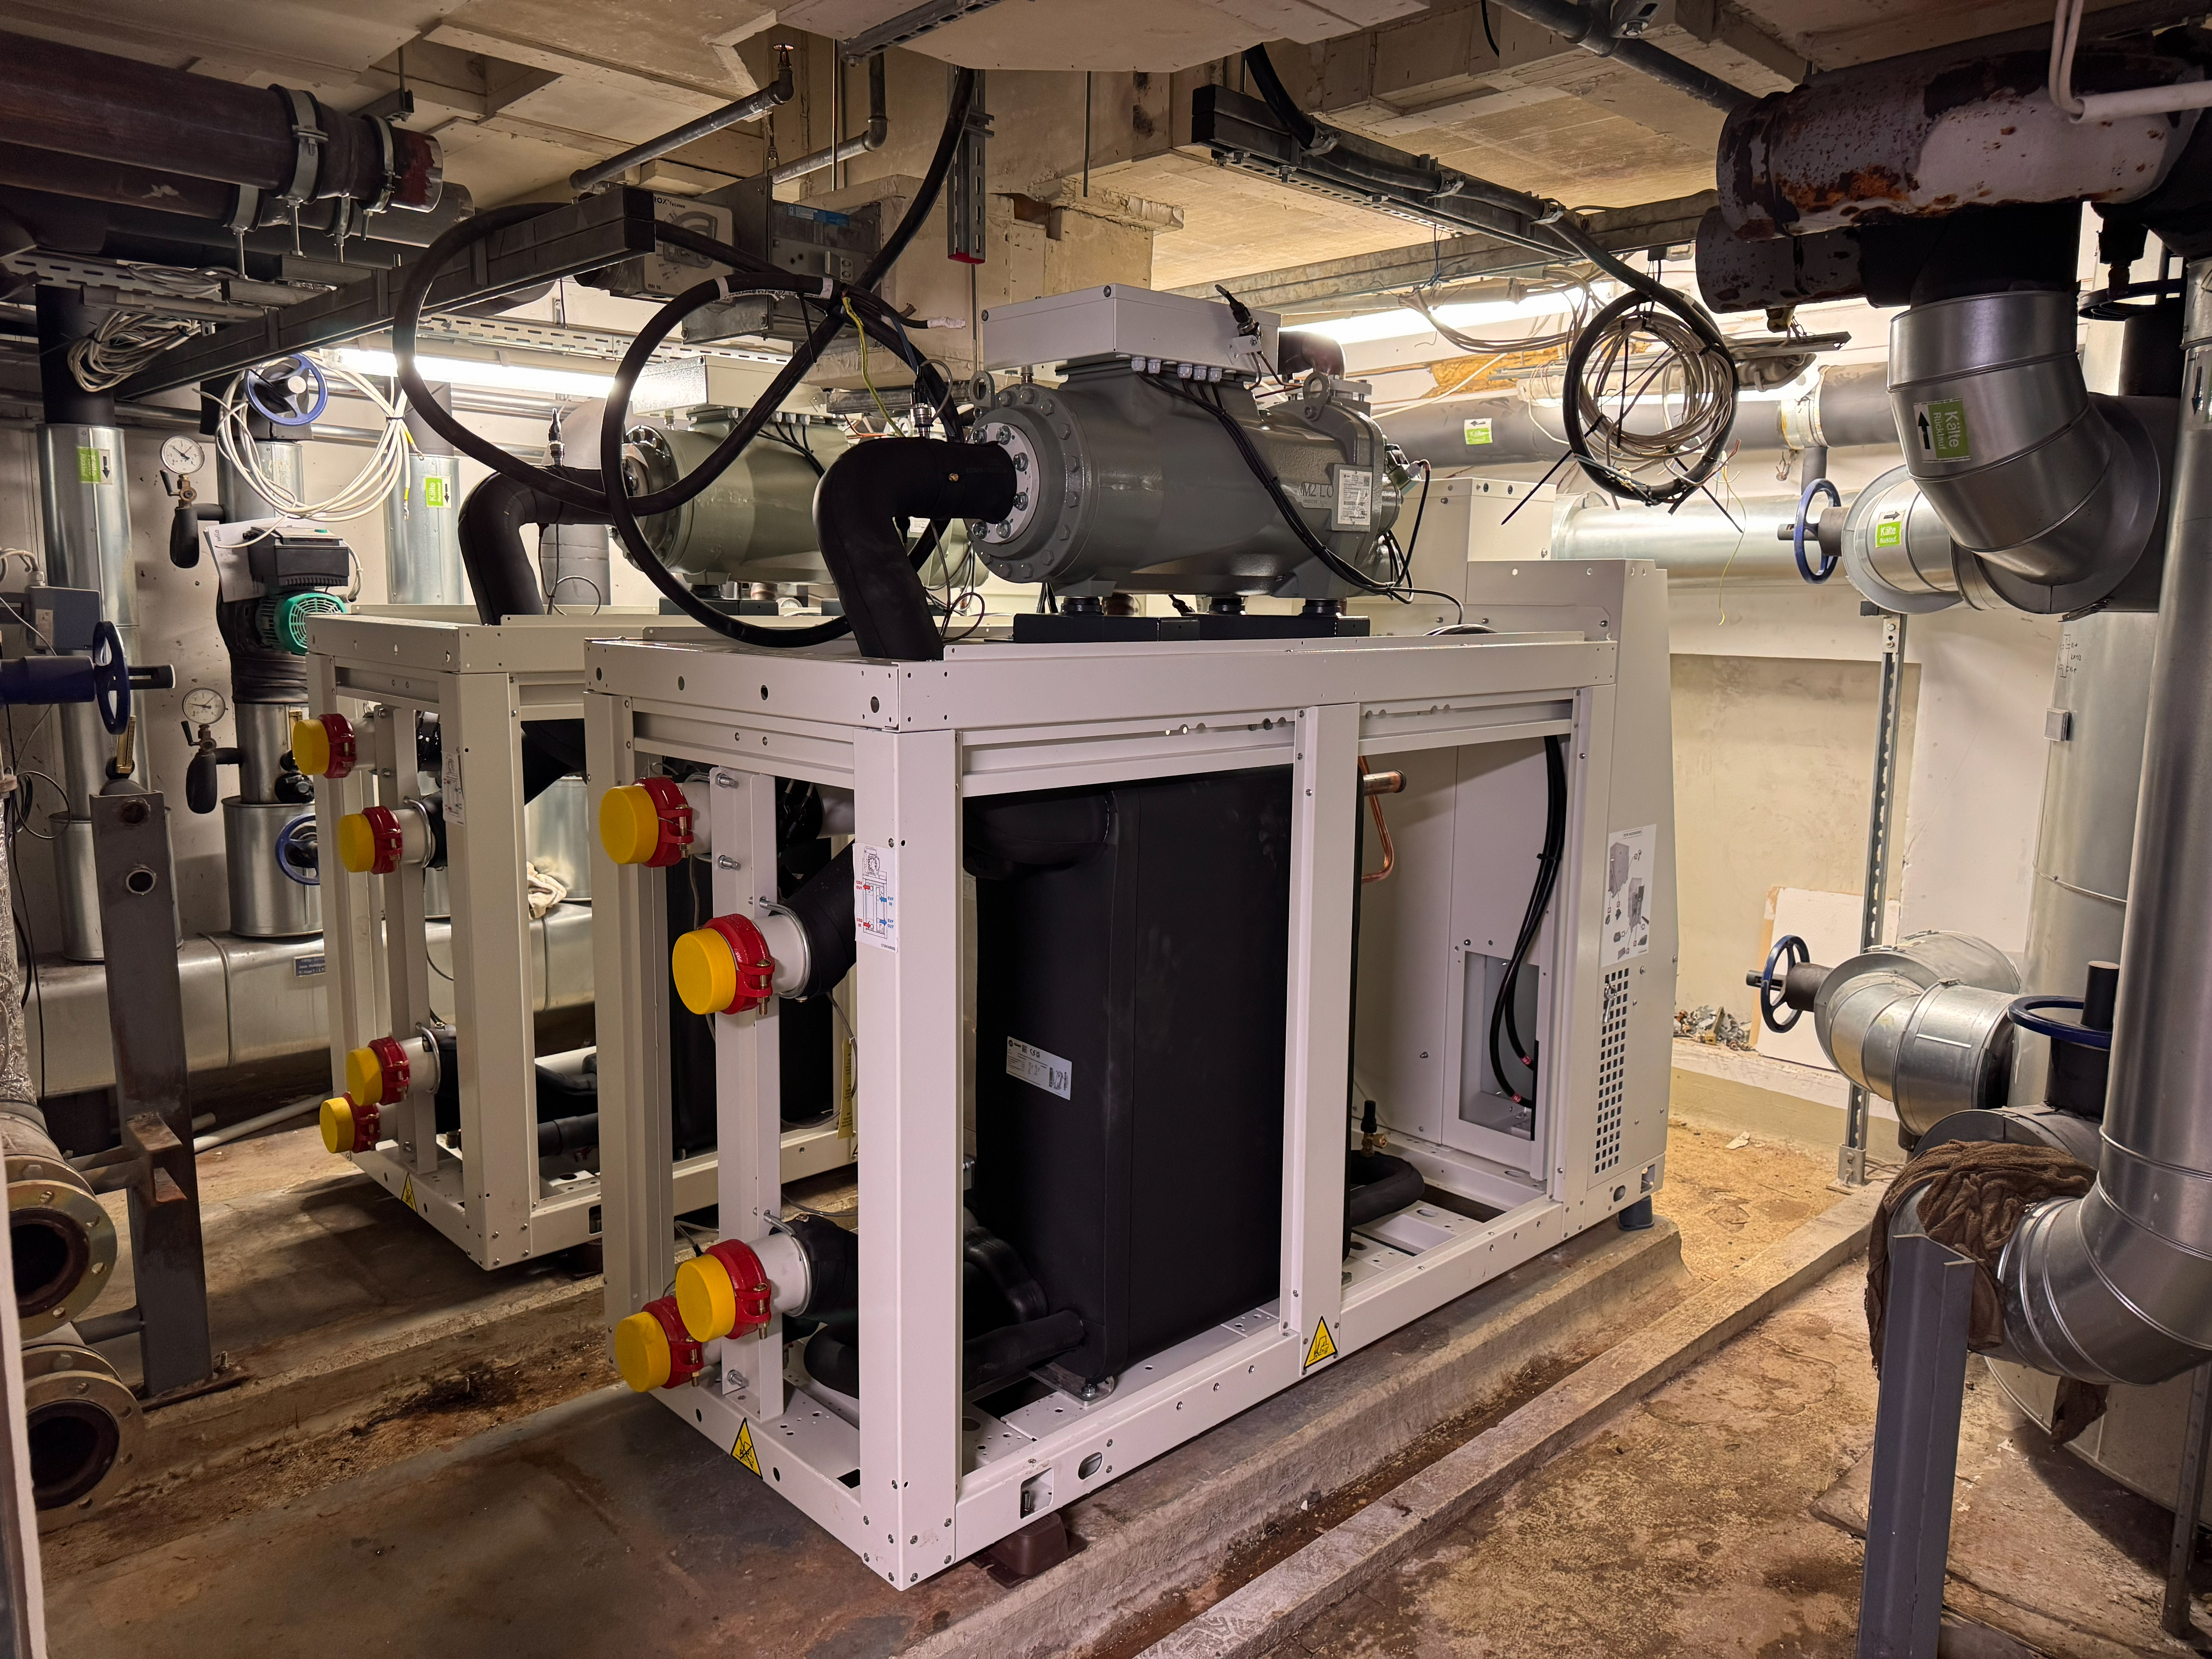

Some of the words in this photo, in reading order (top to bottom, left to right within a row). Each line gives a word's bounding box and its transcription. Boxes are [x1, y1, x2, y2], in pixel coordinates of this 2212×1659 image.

[1933, 412, 1947, 450] Rücklauf
[1944, 411, 1961, 447] Kälte
[1881, 526, 1896, 536] Kälte
